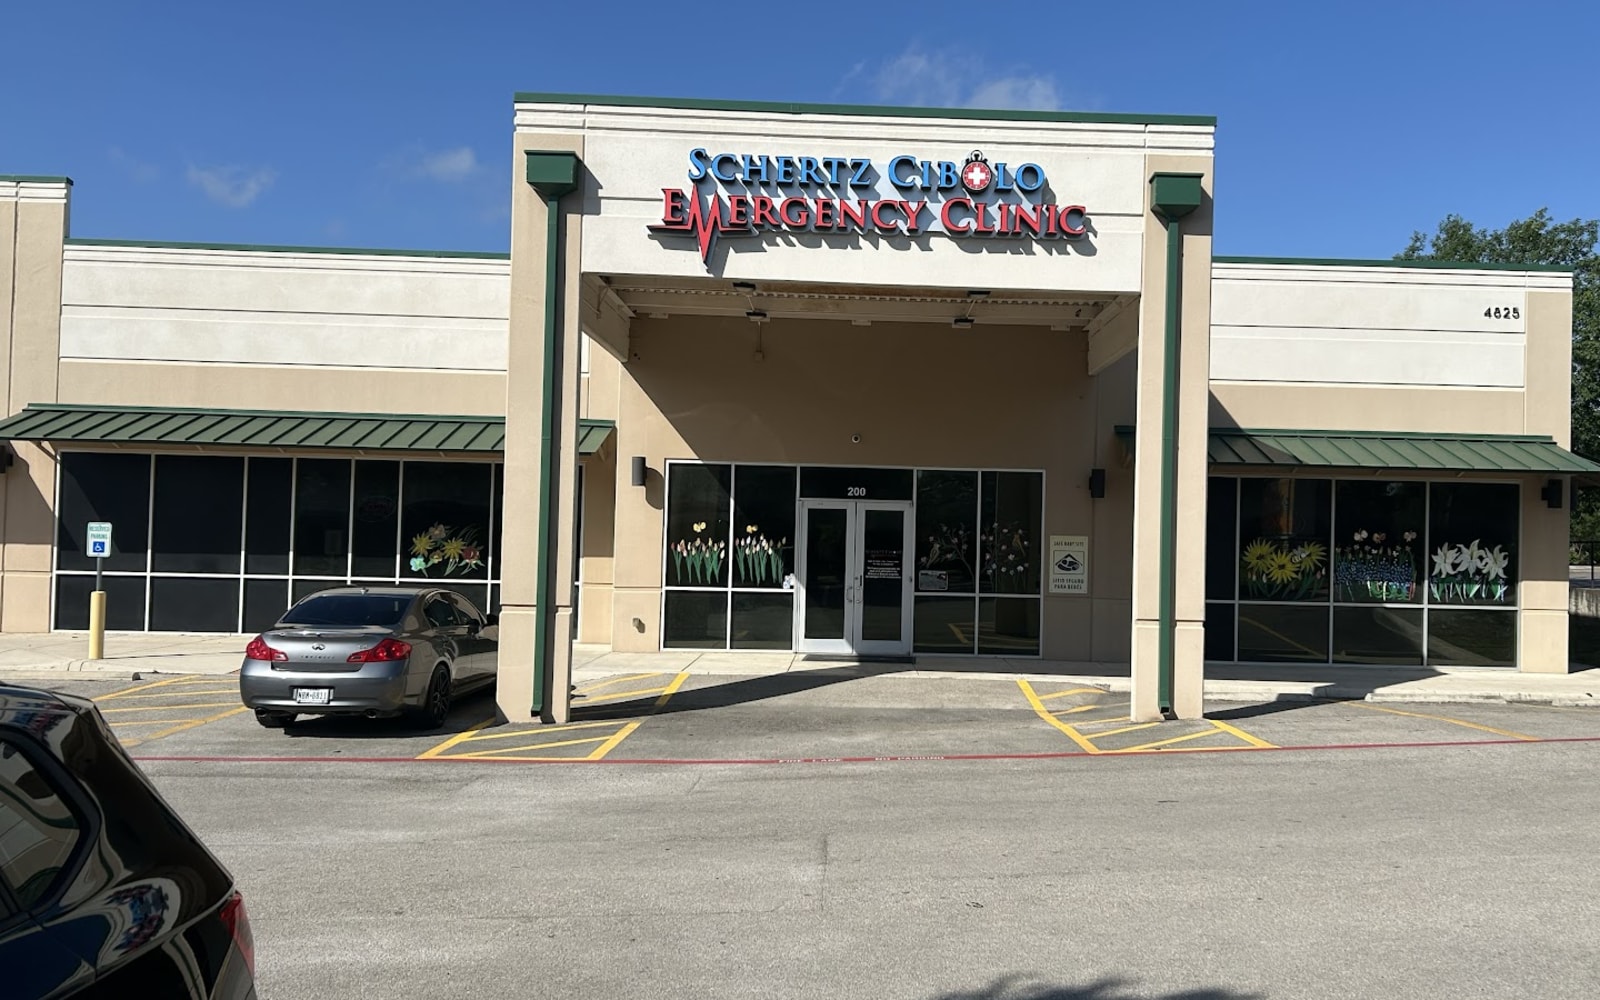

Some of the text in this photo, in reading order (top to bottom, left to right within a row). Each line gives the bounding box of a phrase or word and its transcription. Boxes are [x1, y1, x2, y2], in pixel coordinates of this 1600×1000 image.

[688, 148, 1045, 193] SCHERTZ CIBOLO
[650, 185, 1087, 262] EMERGENCY CLINIC
[847, 487, 866, 496] 200
